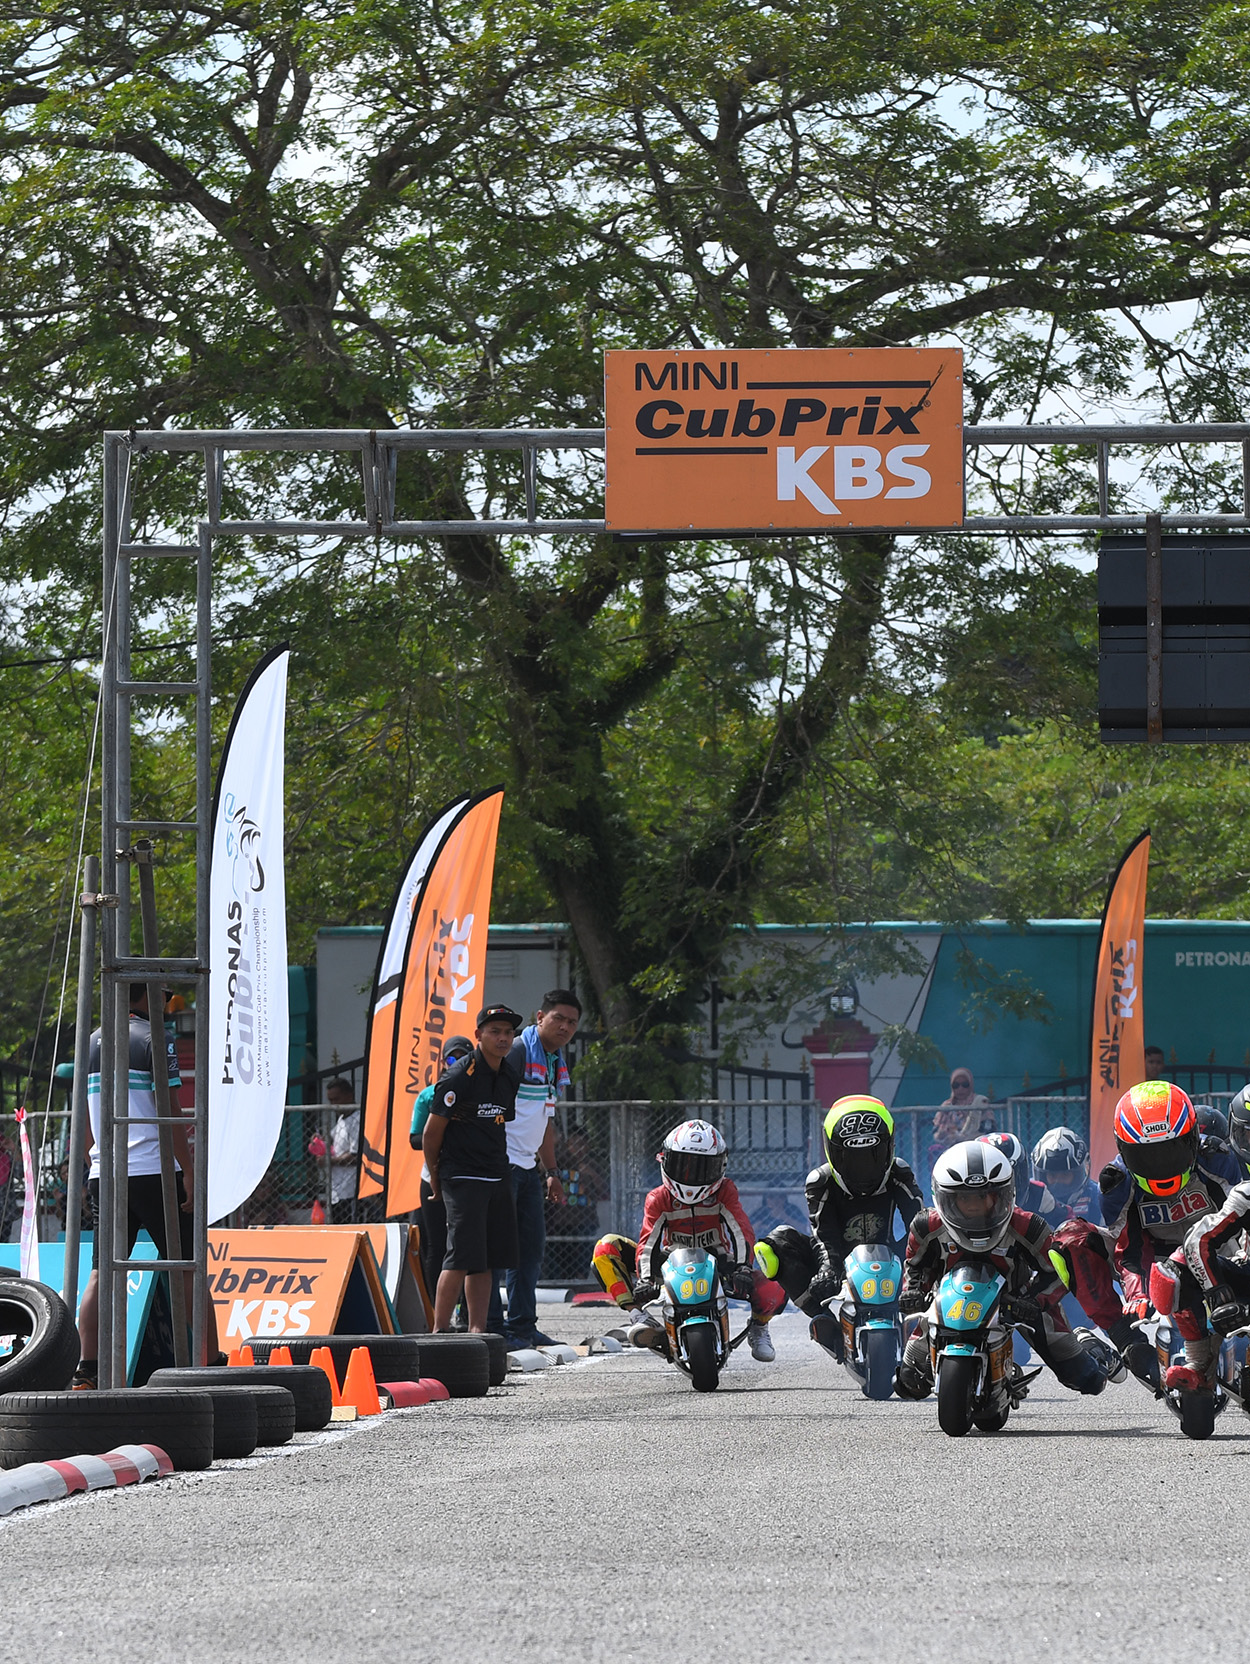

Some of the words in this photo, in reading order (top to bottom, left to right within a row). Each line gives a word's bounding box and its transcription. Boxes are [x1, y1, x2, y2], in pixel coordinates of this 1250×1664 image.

[635, 361, 738, 391] MINI
[635, 396, 925, 439] CubPrix
[776, 444, 932, 515] KBS
[252, 907, 261, 972] Championship
[405, 1027, 421, 1094] MINI
[839, 1113, 882, 1138] 99
[1145, 1123, 1167, 1134] SHOEI
[848, 1137, 877, 1147] HJC
[1142, 1191, 1208, 1225] Blata
[207, 1242, 229, 1261] NI
[697, 1230, 715, 1248] TEAM
[681, 1278, 709, 1299] 90
[861, 1278, 895, 1300] 99
[225, 1299, 316, 1340] KBS
[947, 1299, 983, 1322] 46
